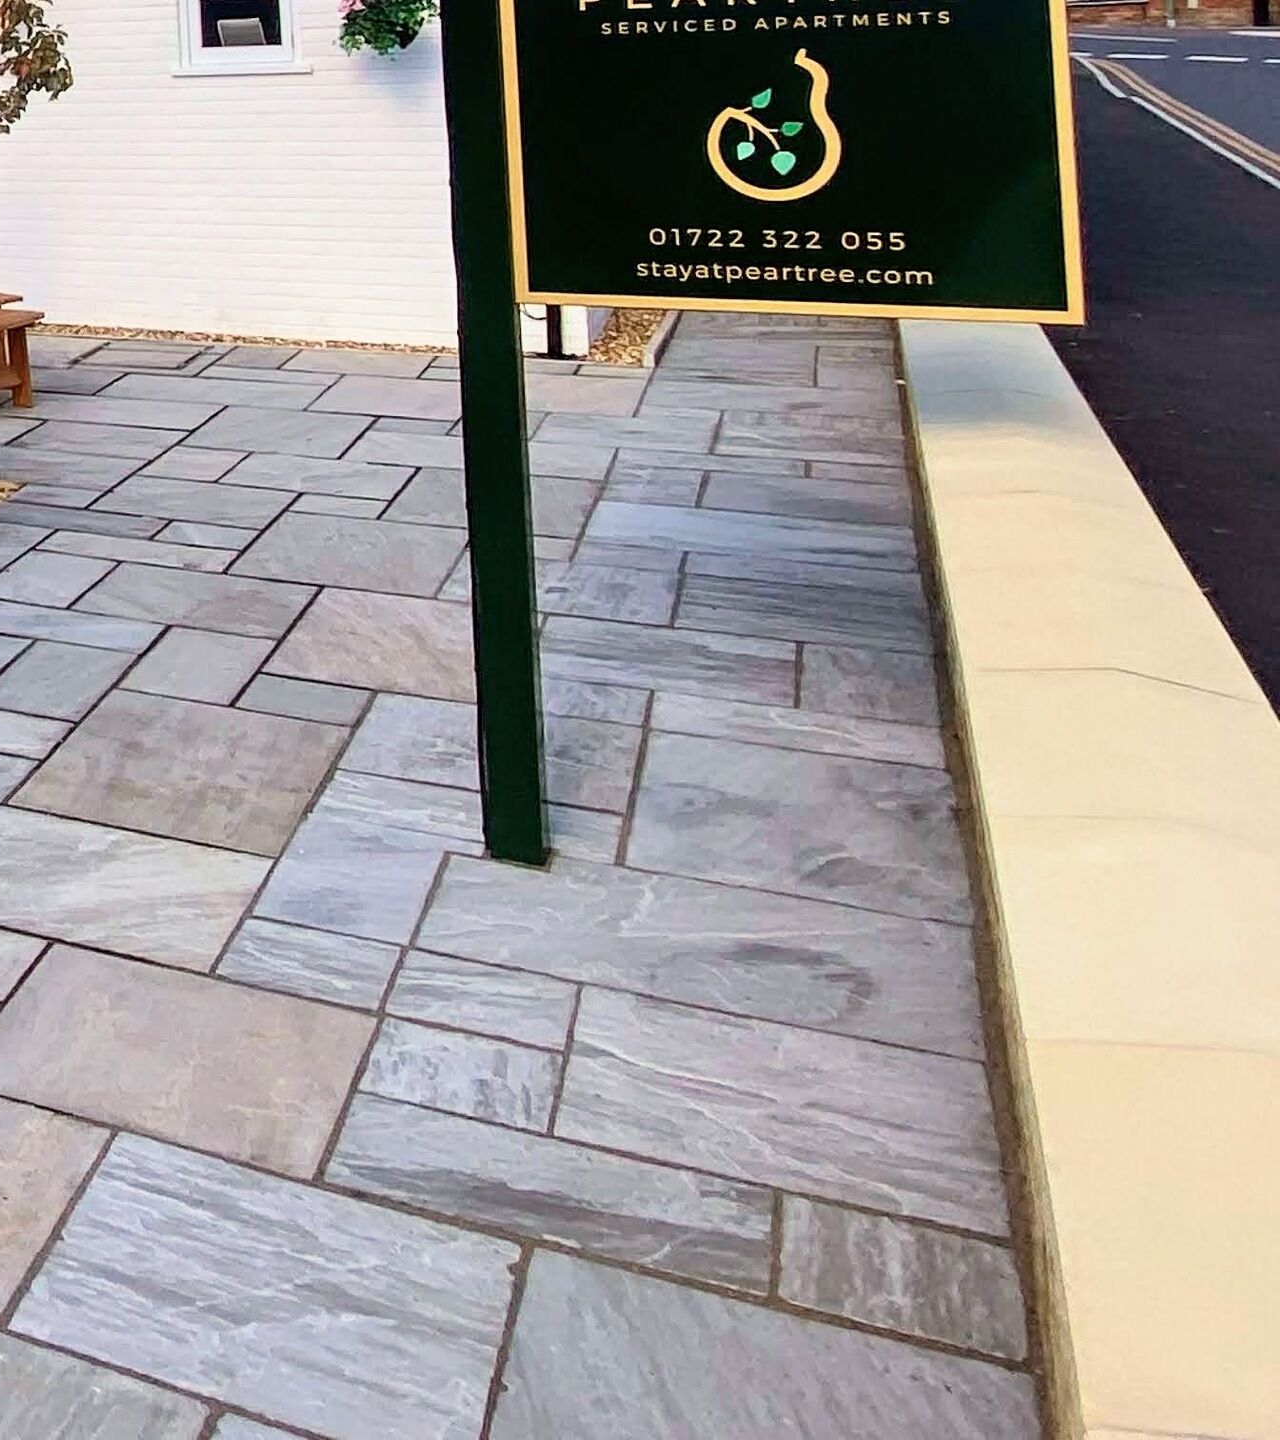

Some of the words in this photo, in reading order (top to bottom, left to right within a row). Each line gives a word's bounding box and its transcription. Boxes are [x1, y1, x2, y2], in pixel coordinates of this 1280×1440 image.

[600, 17, 738, 35] SERVICED
[754, 10, 951, 30] APARTMENTS
[649, 227, 745, 248] 01722
[762, 229, 823, 250] 322
[841, 231, 907, 252] 055
[636, 261, 935, 287] stayatpeartree.com
